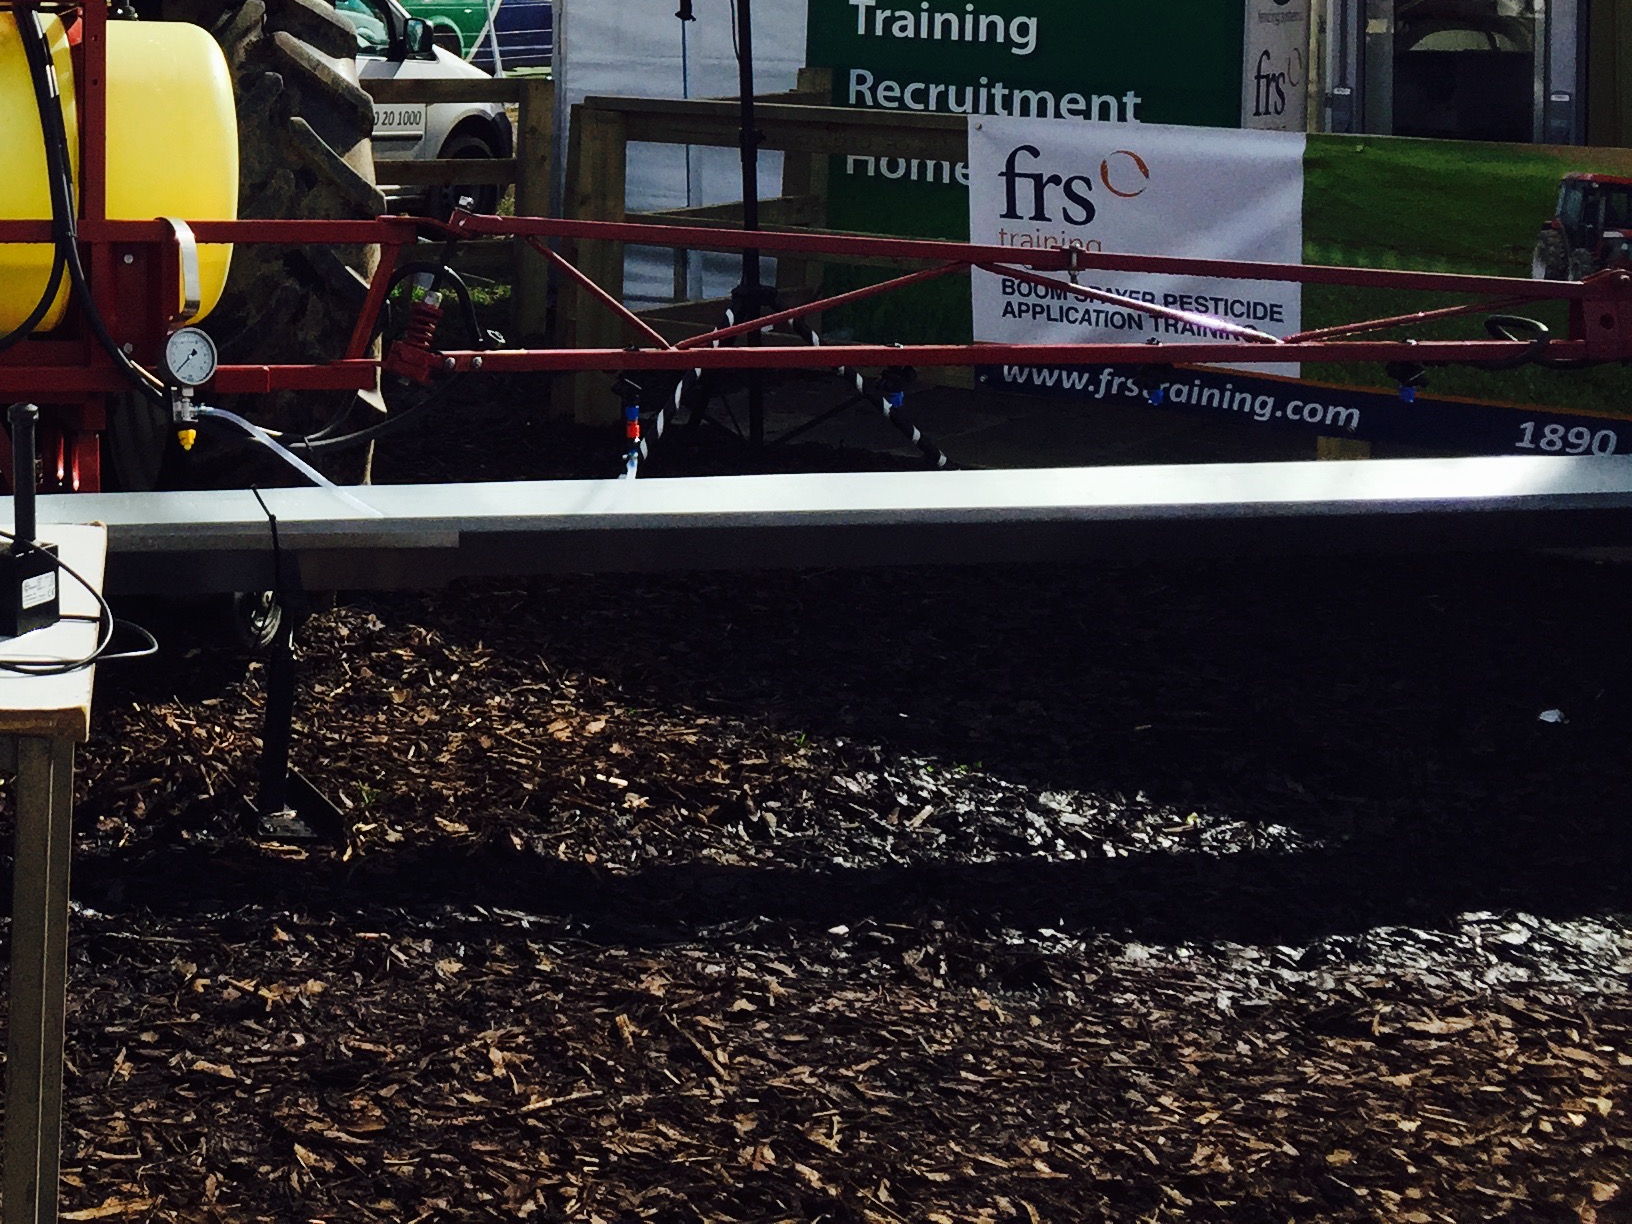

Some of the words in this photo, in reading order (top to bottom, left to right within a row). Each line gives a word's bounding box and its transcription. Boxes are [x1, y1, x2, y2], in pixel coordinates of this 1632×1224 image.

[849, 0, 1038, 56] Training
[848, 69, 1142, 123] Recruitment
[1253, 49, 1286, 117] frs
[381, 111, 395, 126] 20
[397, 111, 422, 126] 1000
[998, 145, 1096, 226] frs
[1001, 301, 1143, 332] APPLICATION
[1149, 314, 1258, 342] TRAIN
[1163, 293, 1285, 323] PESTICIDE
[1002, 364, 1361, 430] www.frsaining.com
[1515, 421, 1618, 457] 1890
